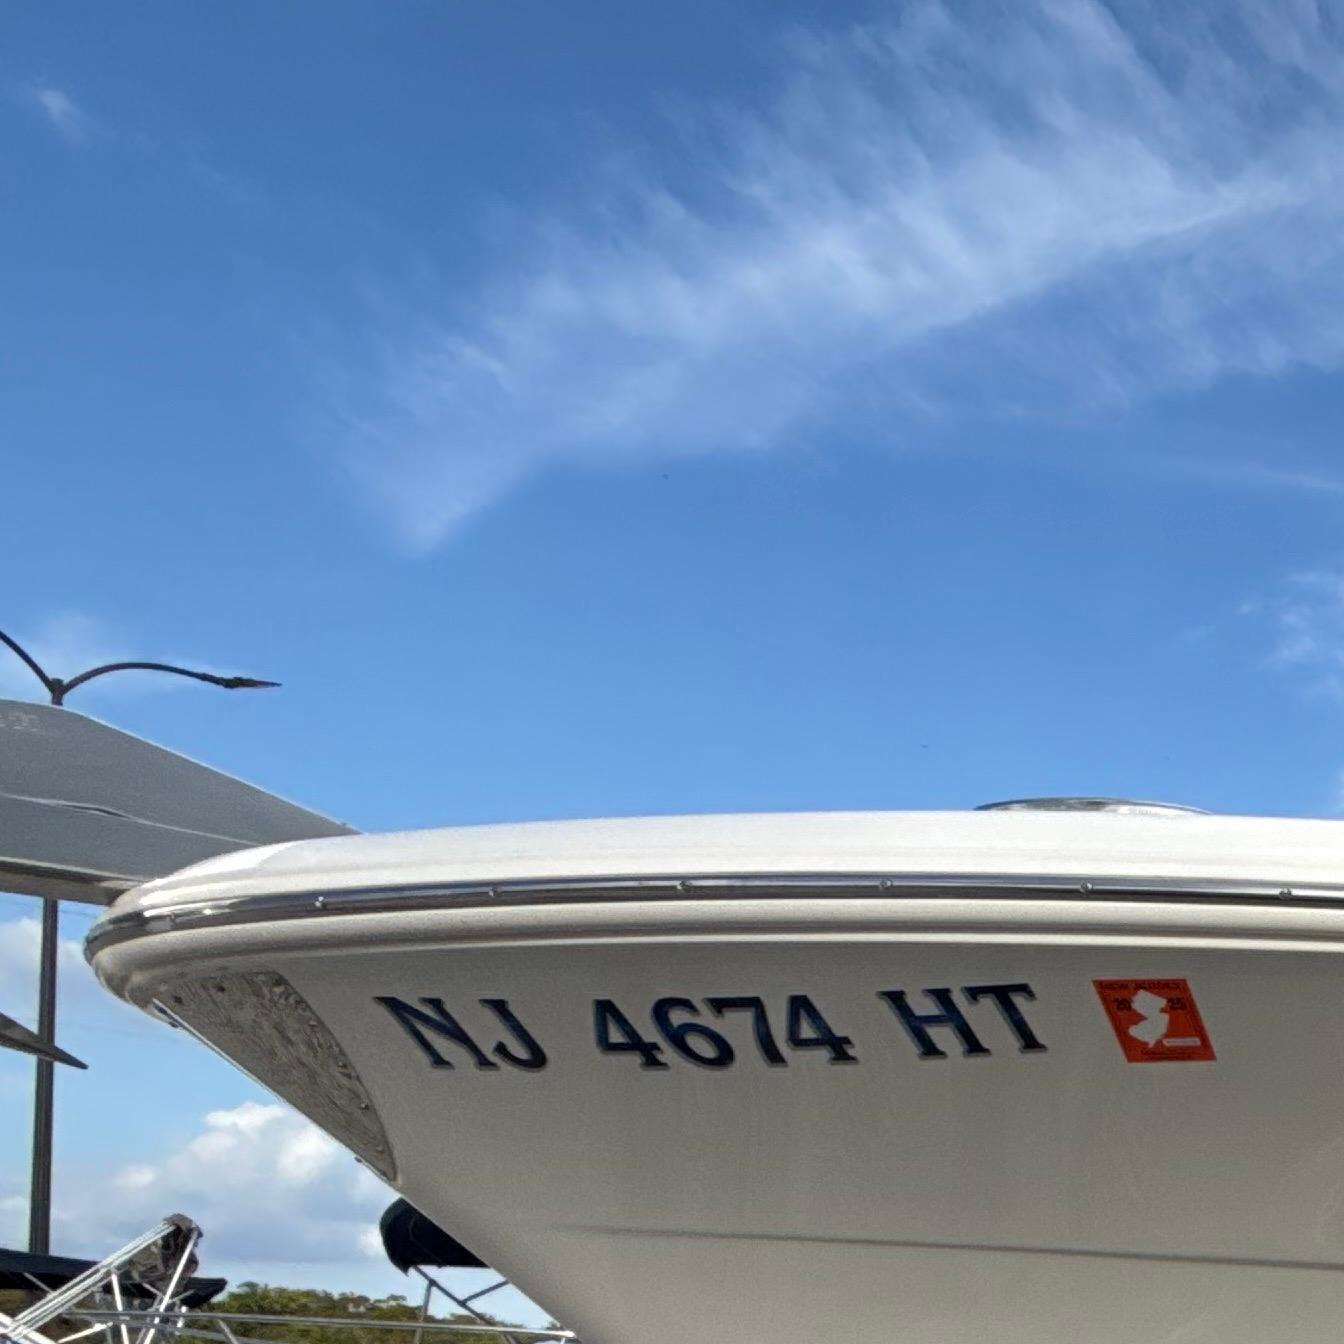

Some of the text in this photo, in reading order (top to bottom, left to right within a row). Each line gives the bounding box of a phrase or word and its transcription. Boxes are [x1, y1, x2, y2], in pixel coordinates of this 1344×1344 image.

[373, 983, 1047, 1073] NJ 4674 HT
